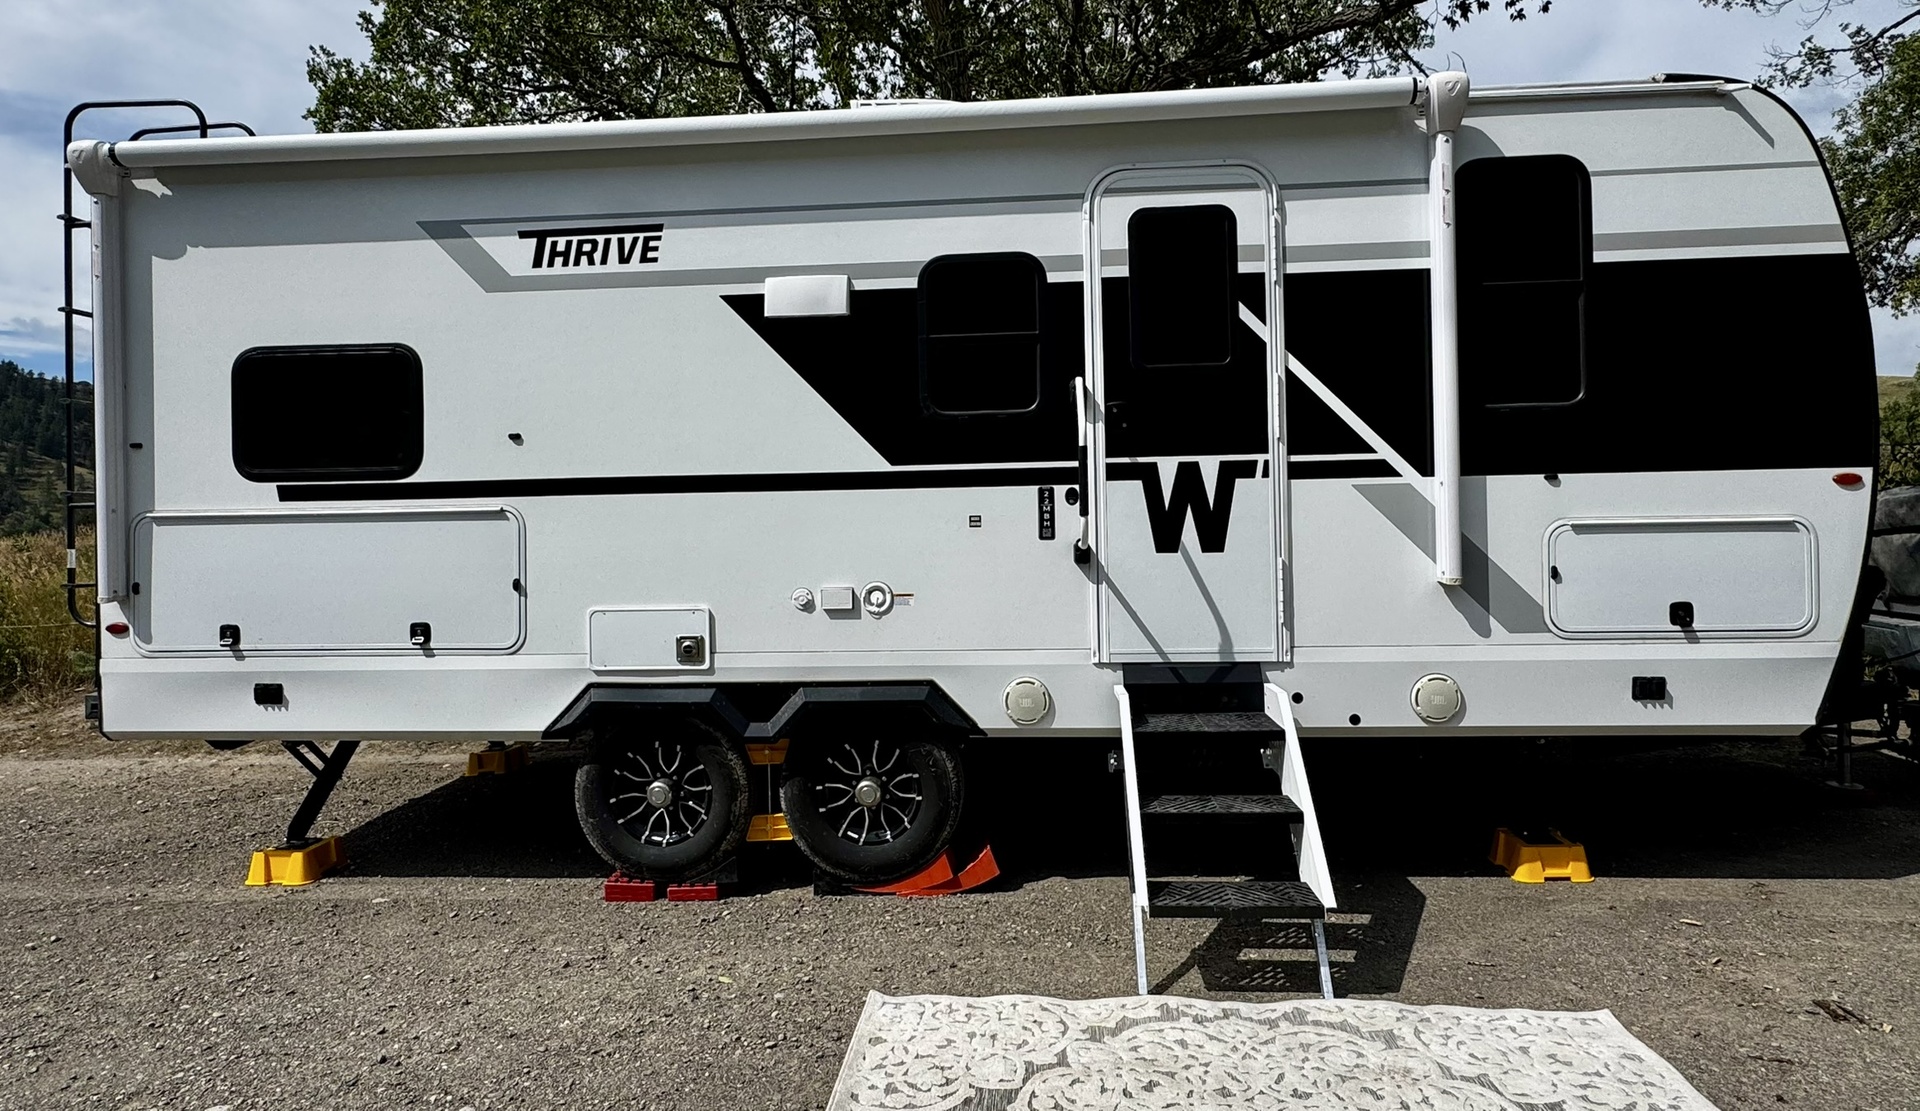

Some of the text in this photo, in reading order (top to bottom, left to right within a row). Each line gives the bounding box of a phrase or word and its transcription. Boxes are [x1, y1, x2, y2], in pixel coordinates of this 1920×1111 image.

[517, 223, 664, 268] THRIVE
[1043, 490, 1051, 527] 22MBH
[1135, 459, 1257, 554] W
